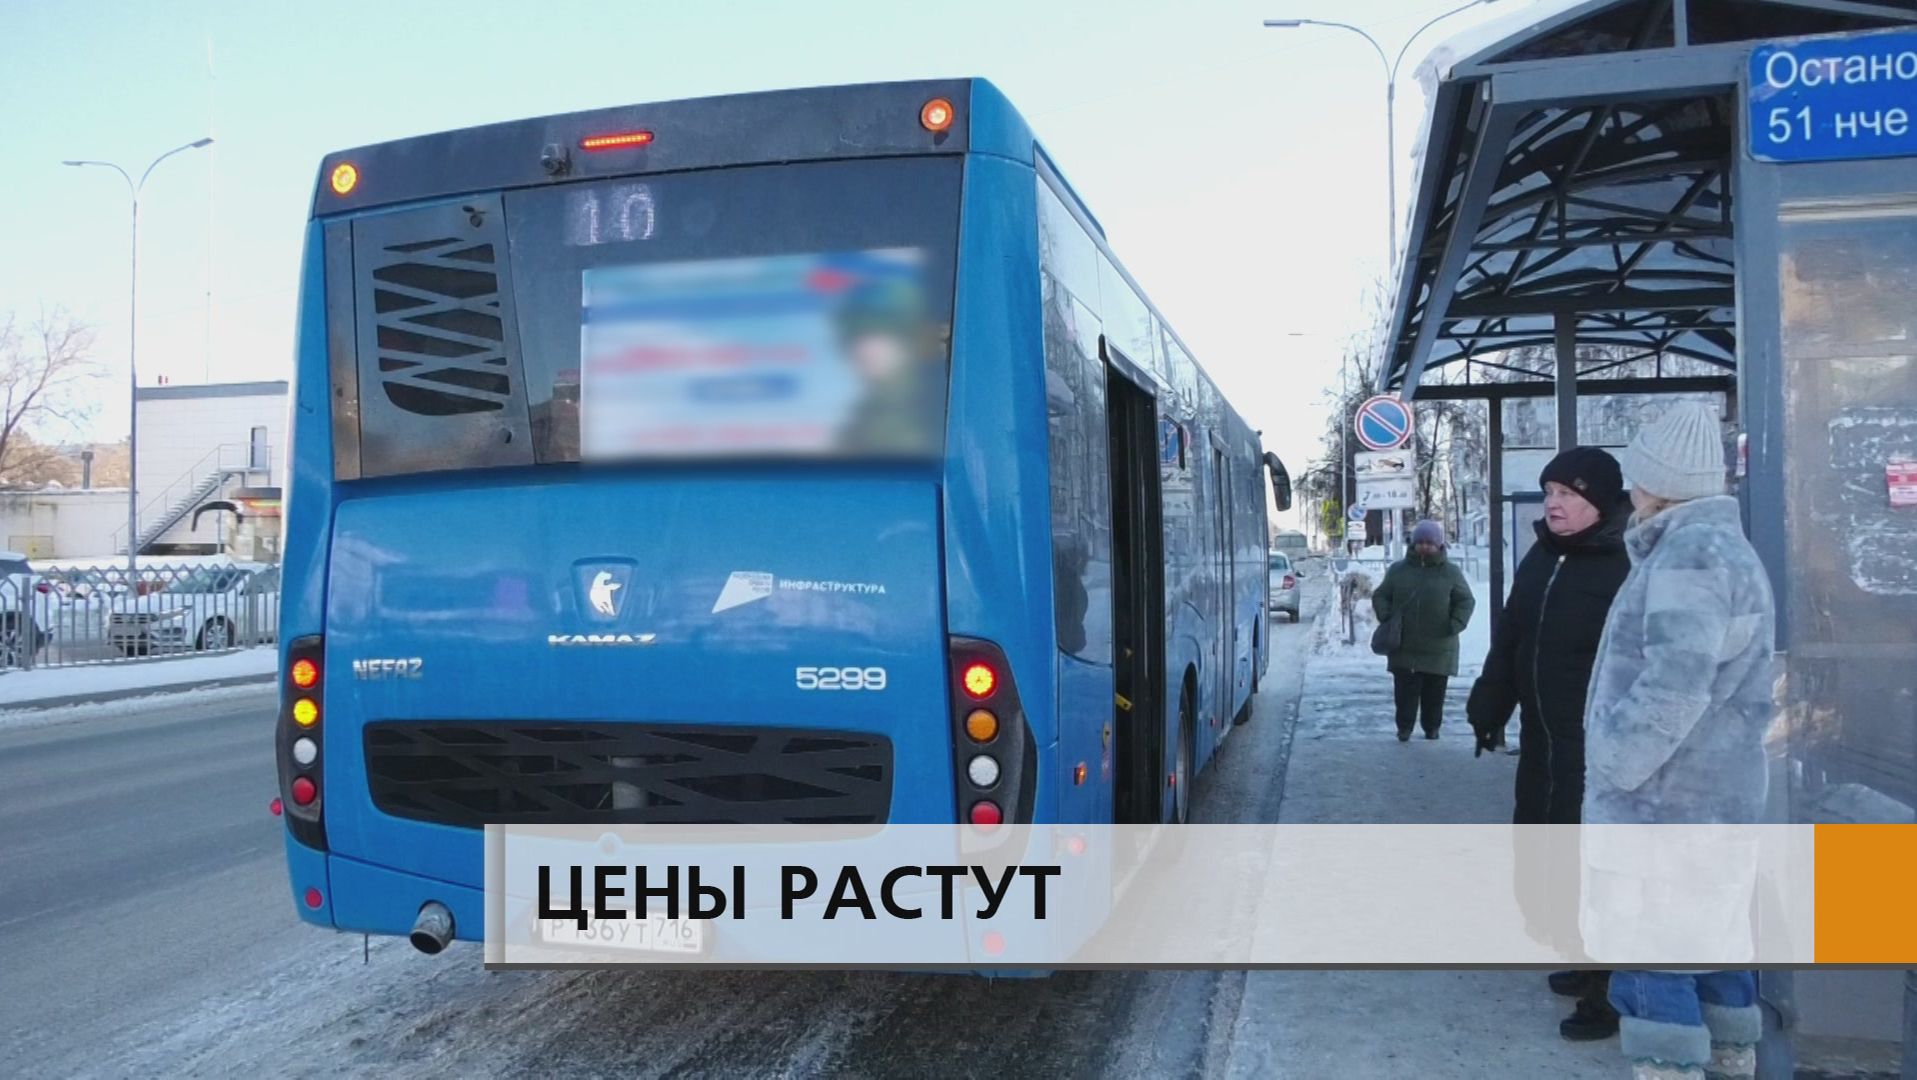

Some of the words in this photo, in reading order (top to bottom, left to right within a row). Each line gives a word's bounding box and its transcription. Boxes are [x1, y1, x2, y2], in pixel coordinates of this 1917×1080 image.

[1765, 51, 1917, 88] Остано
[1768, 105, 1811, 143] 51
[1835, 108, 1908, 138] нче
[582, 193, 654, 243] 10
[779, 579, 886, 594] ИНФРАСТРУКТУРА
[352, 657, 423, 680] NEFAZ
[795, 666, 887, 691] 5299
